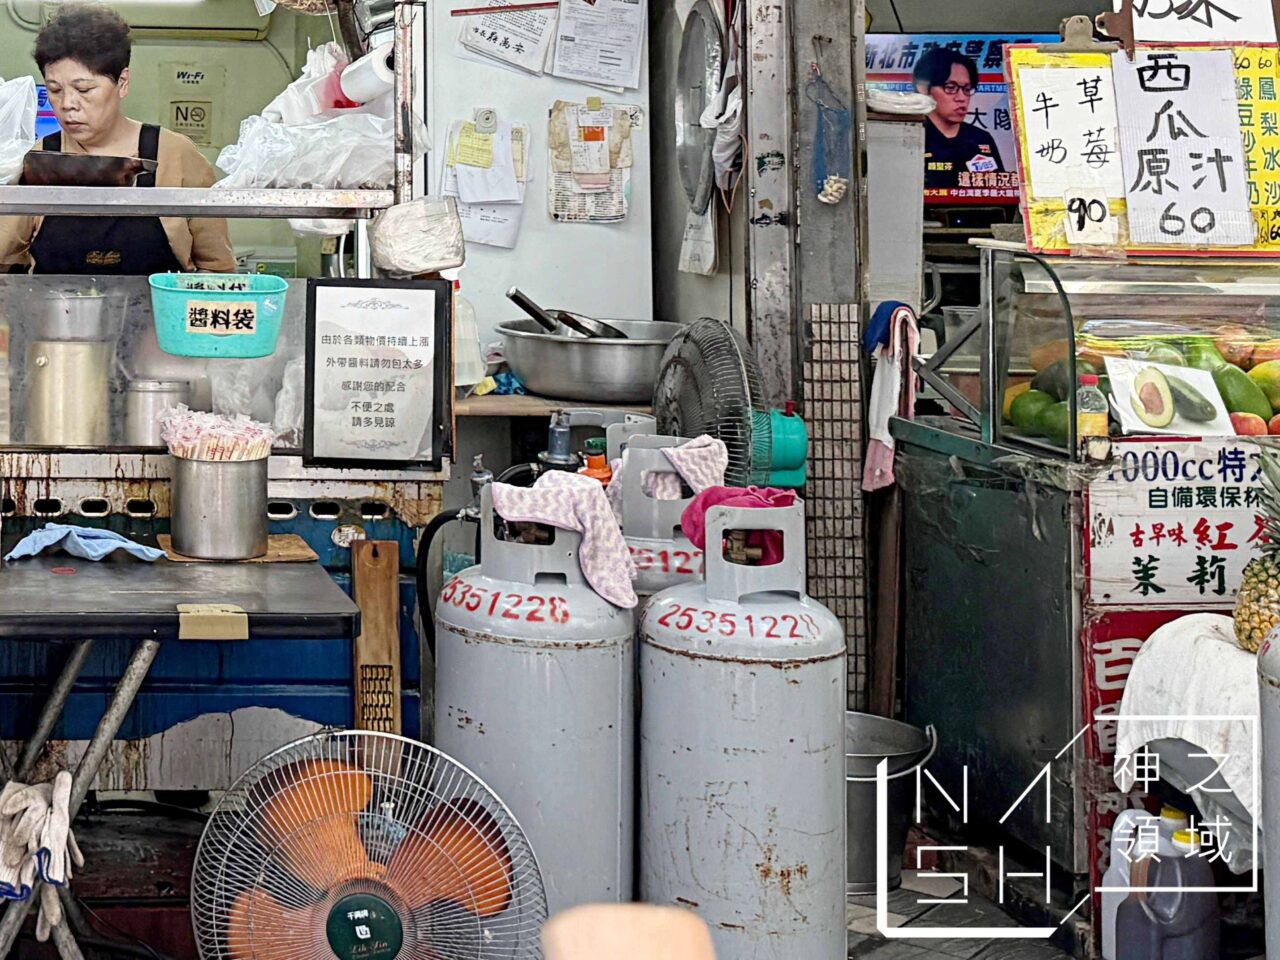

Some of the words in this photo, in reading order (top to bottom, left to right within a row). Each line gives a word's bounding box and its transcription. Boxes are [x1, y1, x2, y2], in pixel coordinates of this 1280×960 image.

[1137, 54, 1209, 142] 西瓜
[1032, 92, 1068, 164] 牛奶
[1076, 75, 1116, 169] 草莓
[1258, 76, 1280, 206] 鳳梨冰沙
[1130, 148, 1234, 195] 原汁
[1068, 197, 1107, 231] 90
[1159, 202, 1216, 237] 60
[188, 307, 255, 331] 醬料袋
[341, 380, 407, 393] 感謝您的配合
[351, 401, 395, 414] 不便之處
[351, 416, 396, 429] 請多見諒
[1108, 447, 1277, 484] 000cc特
[1131, 554, 1227, 596] 茉莉
